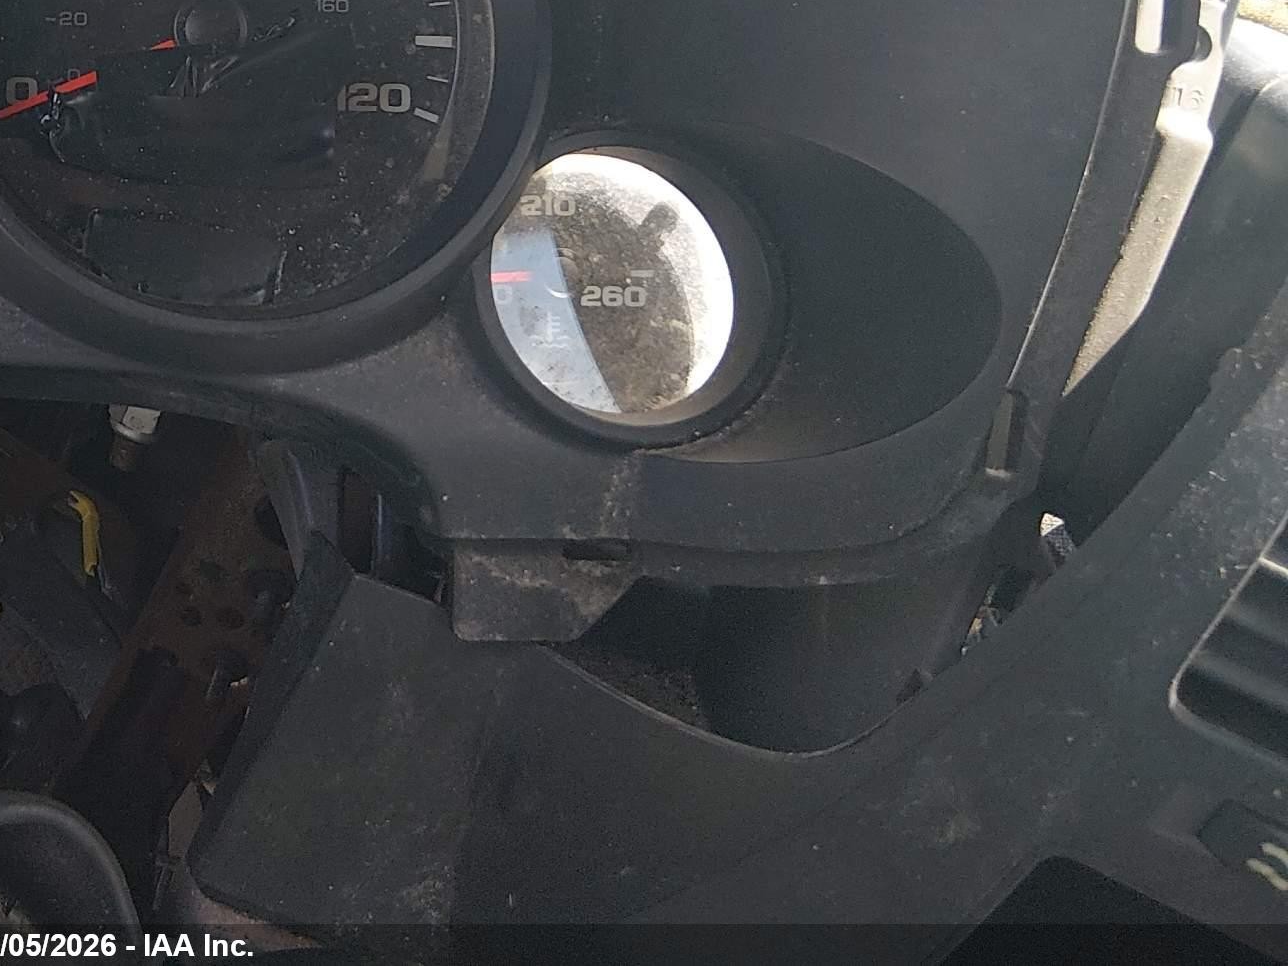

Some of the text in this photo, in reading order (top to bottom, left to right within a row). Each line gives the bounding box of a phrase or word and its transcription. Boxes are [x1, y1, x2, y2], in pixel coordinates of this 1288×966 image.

[58, 12, 88, 26] 20
[6, 76, 39, 108] 0
[520, 194, 576, 217] 210
[580, 285, 648, 307] 260
